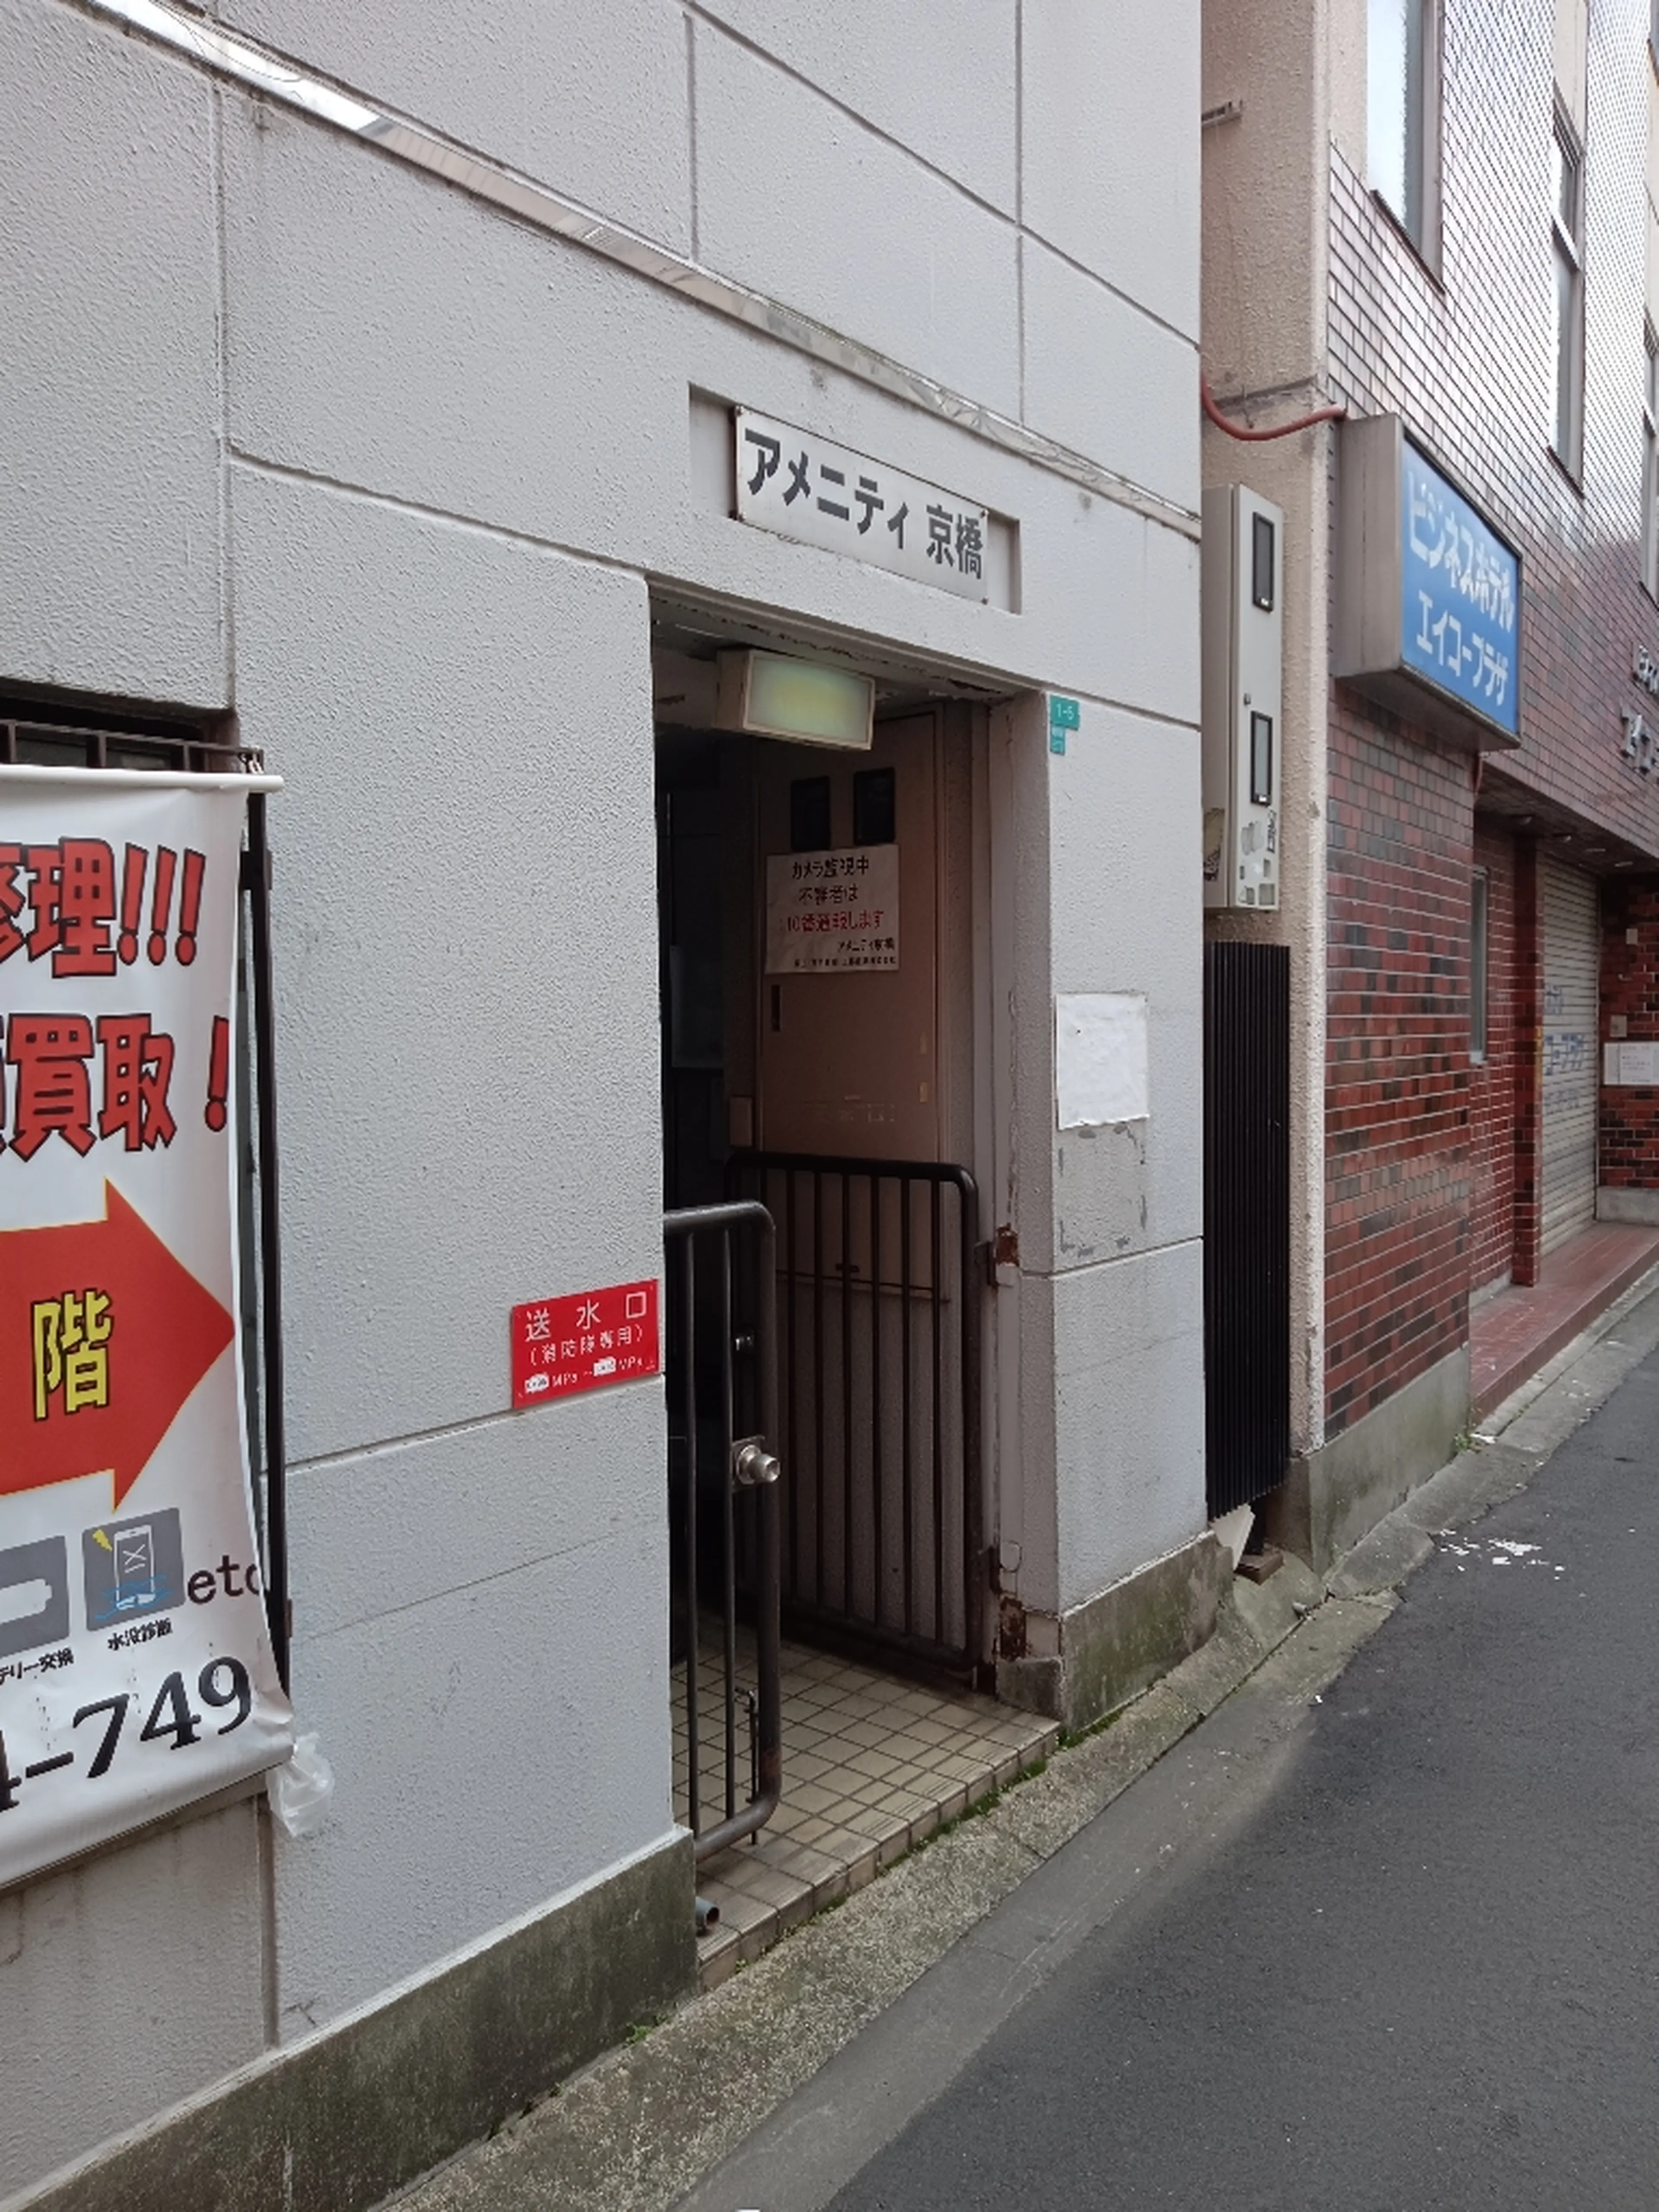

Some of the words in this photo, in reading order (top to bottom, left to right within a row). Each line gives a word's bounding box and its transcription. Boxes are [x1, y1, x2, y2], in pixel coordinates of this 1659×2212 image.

[745, 428, 909, 550] アメニティ
[925, 504, 983, 579] 京橋
[1408, 471, 1514, 632] ビジネスホテル
[1417, 589, 1508, 706] エイコープラザ
[0, 836, 205, 978] 理!!!
[792, 855, 869, 880] カメラ監視中
[798, 884, 858, 906] 不審者は
[31, 1287, 114, 1421] 階
